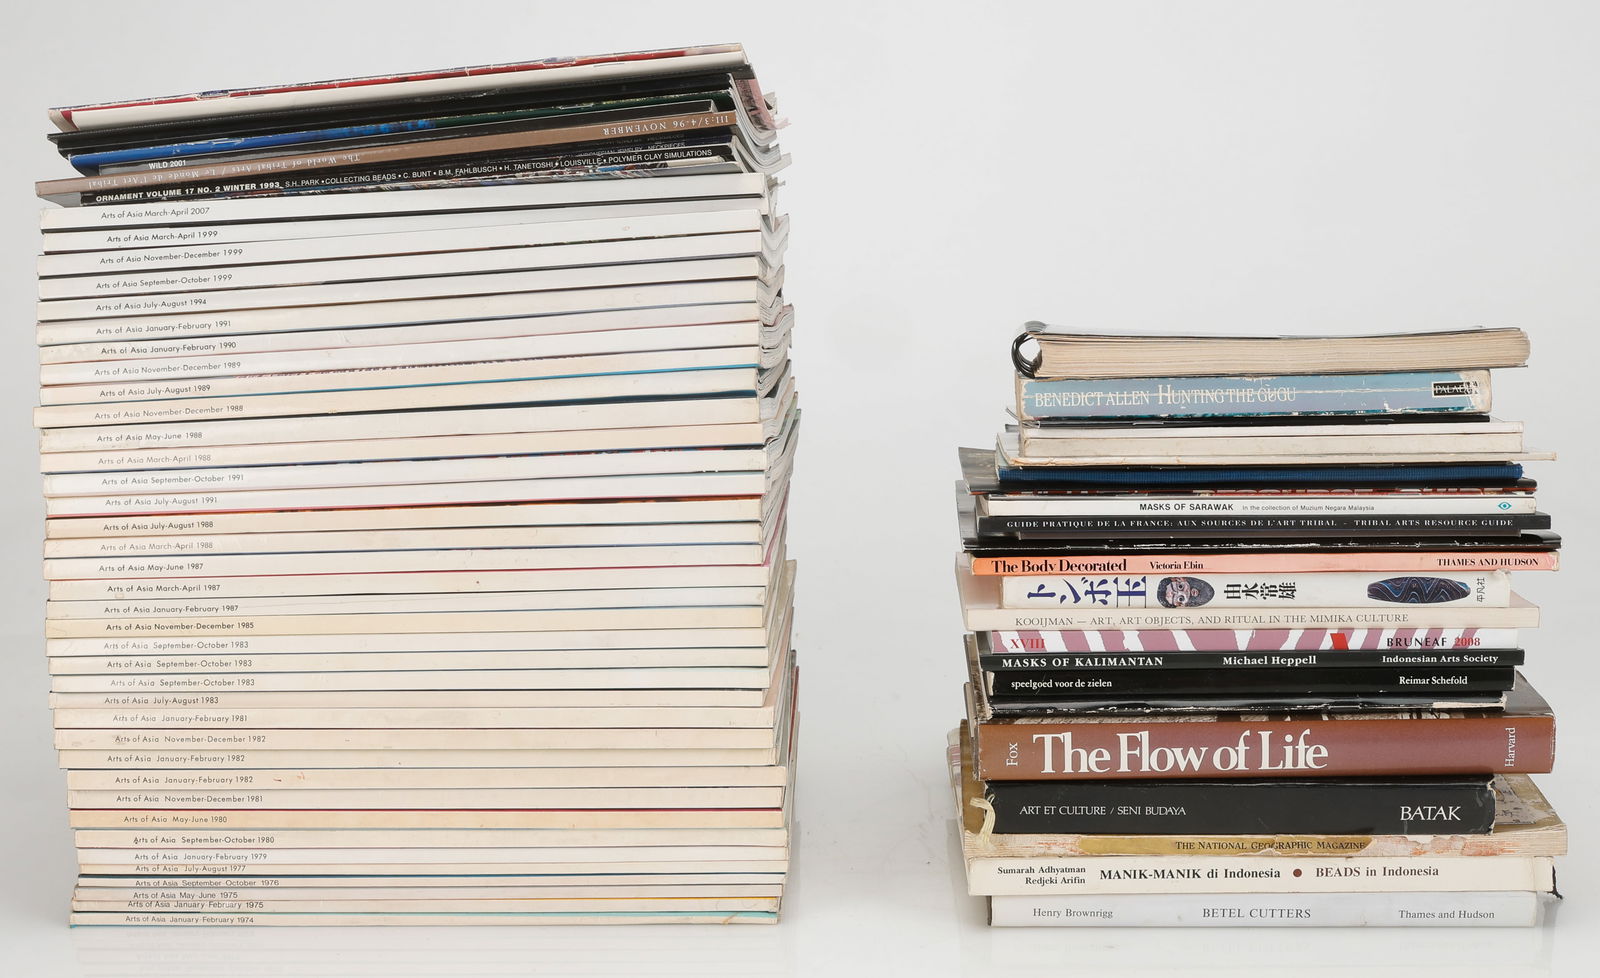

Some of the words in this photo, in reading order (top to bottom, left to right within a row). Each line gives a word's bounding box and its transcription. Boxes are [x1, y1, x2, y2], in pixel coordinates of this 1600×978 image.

[603, 122, 666, 136] NOVEMBER
[308, 158, 336, 166] World
[343, 154, 360, 162] The
[149, 161, 167, 170] WILD
[232, 164, 250, 172] Arts
[258, 162, 287, 171] Tribal
[96, 192, 143, 202] ORNAMENT
[146, 189, 181, 198] VOLUME
[223, 183, 256, 192] WINTER
[326, 176, 370, 184] COLLECTING
[455, 166, 498, 175] FAHLBUSCH
[514, 161, 553, 170] TANETOSHI
[560, 158, 600, 167] LOUISVILLE
[608, 155, 642, 163] POLYMER
[664, 150, 712, 160] SIMULATIONS
[102, 211, 116, 219] Arts
[145, 208, 188, 218] March-April
[1035, 392, 1103, 408] BENEDICT
[1106, 390, 1150, 406] ALLEN
[1227, 388, 1254, 403] THE
[1140, 504, 1170, 512] MASKS
[1174, 503, 1186, 511] OF
[1190, 503, 1234, 511] SARAWAK
[150, 521, 194, 532] July-August
[992, 560, 1018, 573] The
[1022, 560, 1057, 573] Body
[1059, 558, 1127, 572] Decorated
[1150, 561, 1181, 570] Victoria
[1183, 561, 1204, 570] Ebin
[1437, 558, 1476, 566] THAMES
[1479, 558, 1498, 566] AND
[1500, 558, 1538, 566] HUDSON
[154, 622, 234, 630] November-December
[1015, 617, 1073, 628] KOOIJMAN
[1090, 616, 1116, 627] ART,
[1120, 616, 1142, 625] ART
[1145, 615, 1194, 628] OBJECTS,
[1198, 616, 1221, 624] AND
[1224, 615, 1265, 624] RITUAL
[1269, 615, 1281, 624] IN
[1284, 614, 1307, 623] THE
[1310, 614, 1353, 623] MIMIKA
[1356, 614, 1409, 623] CULTURE
[1010, 638, 1045, 649] XVIII
[1387, 637, 1448, 647] BRUNEAF
[1454, 637, 1480, 647] 2008
[1002, 658, 1046, 668] MASKS
[1052, 658, 1070, 667] OF
[1075, 656, 1163, 667] KALIMANTAN
[1223, 656, 1268, 665] Michael
[1272, 655, 1317, 666] Heppell
[1382, 655, 1436, 663] Indonesian
[1440, 655, 1460, 663] Arts
[1464, 654, 1498, 665] Society
[1011, 679, 1053, 690] speelgoed
[1075, 679, 1086, 688] de
[1087, 678, 1112, 688] zielen
[1399, 676, 1430, 685] Reimar
[1432, 676, 1468, 685] Schefold
[1006, 742, 1018, 766] Fox
[1033, 732, 1111, 773] The
[1116, 731, 1208, 772] Flow
[1212, 730, 1250, 770] of
[1258, 728, 1329, 770] Life
[1504, 727, 1516, 767] Harvard
[1019, 806, 1041, 815] ART
[1044, 806, 1056, 815] ET
[1059, 806, 1106, 815] CULTURE
[1117, 806, 1141, 816] SENI
[1145, 806, 1187, 816] BUDAYA
[1400, 806, 1461, 821] BATAK
[1198, 842, 1247, 850] NATIONAL
[1251, 841, 1312, 850] GEOGRAPHIC
[1316, 841, 1365, 849] MAGAZINE
[1038, 866, 1086, 876] Adhyatman
[1100, 869, 1202, 880] MANIK-MANIK
[1207, 869, 1218, 879] di
[1224, 868, 1281, 879] Indonesia
[1316, 867, 1361, 878] BEADS
[1366, 867, 1377, 877] in
[1382, 866, 1439, 876] Indonesia
[1025, 877, 1058, 887] Redjeki
[1060, 877, 1086, 885] Arifin
[1033, 908, 1062, 919] Henry
[1065, 908, 1113, 919] Brownrigg
[1202, 908, 1245, 918] BETEL
[1249, 908, 1311, 918] CUTTERS
[1399, 910, 1435, 919] Thames
[1438, 910, 1455, 919] and
[1458, 910, 1495, 919] Hudson
